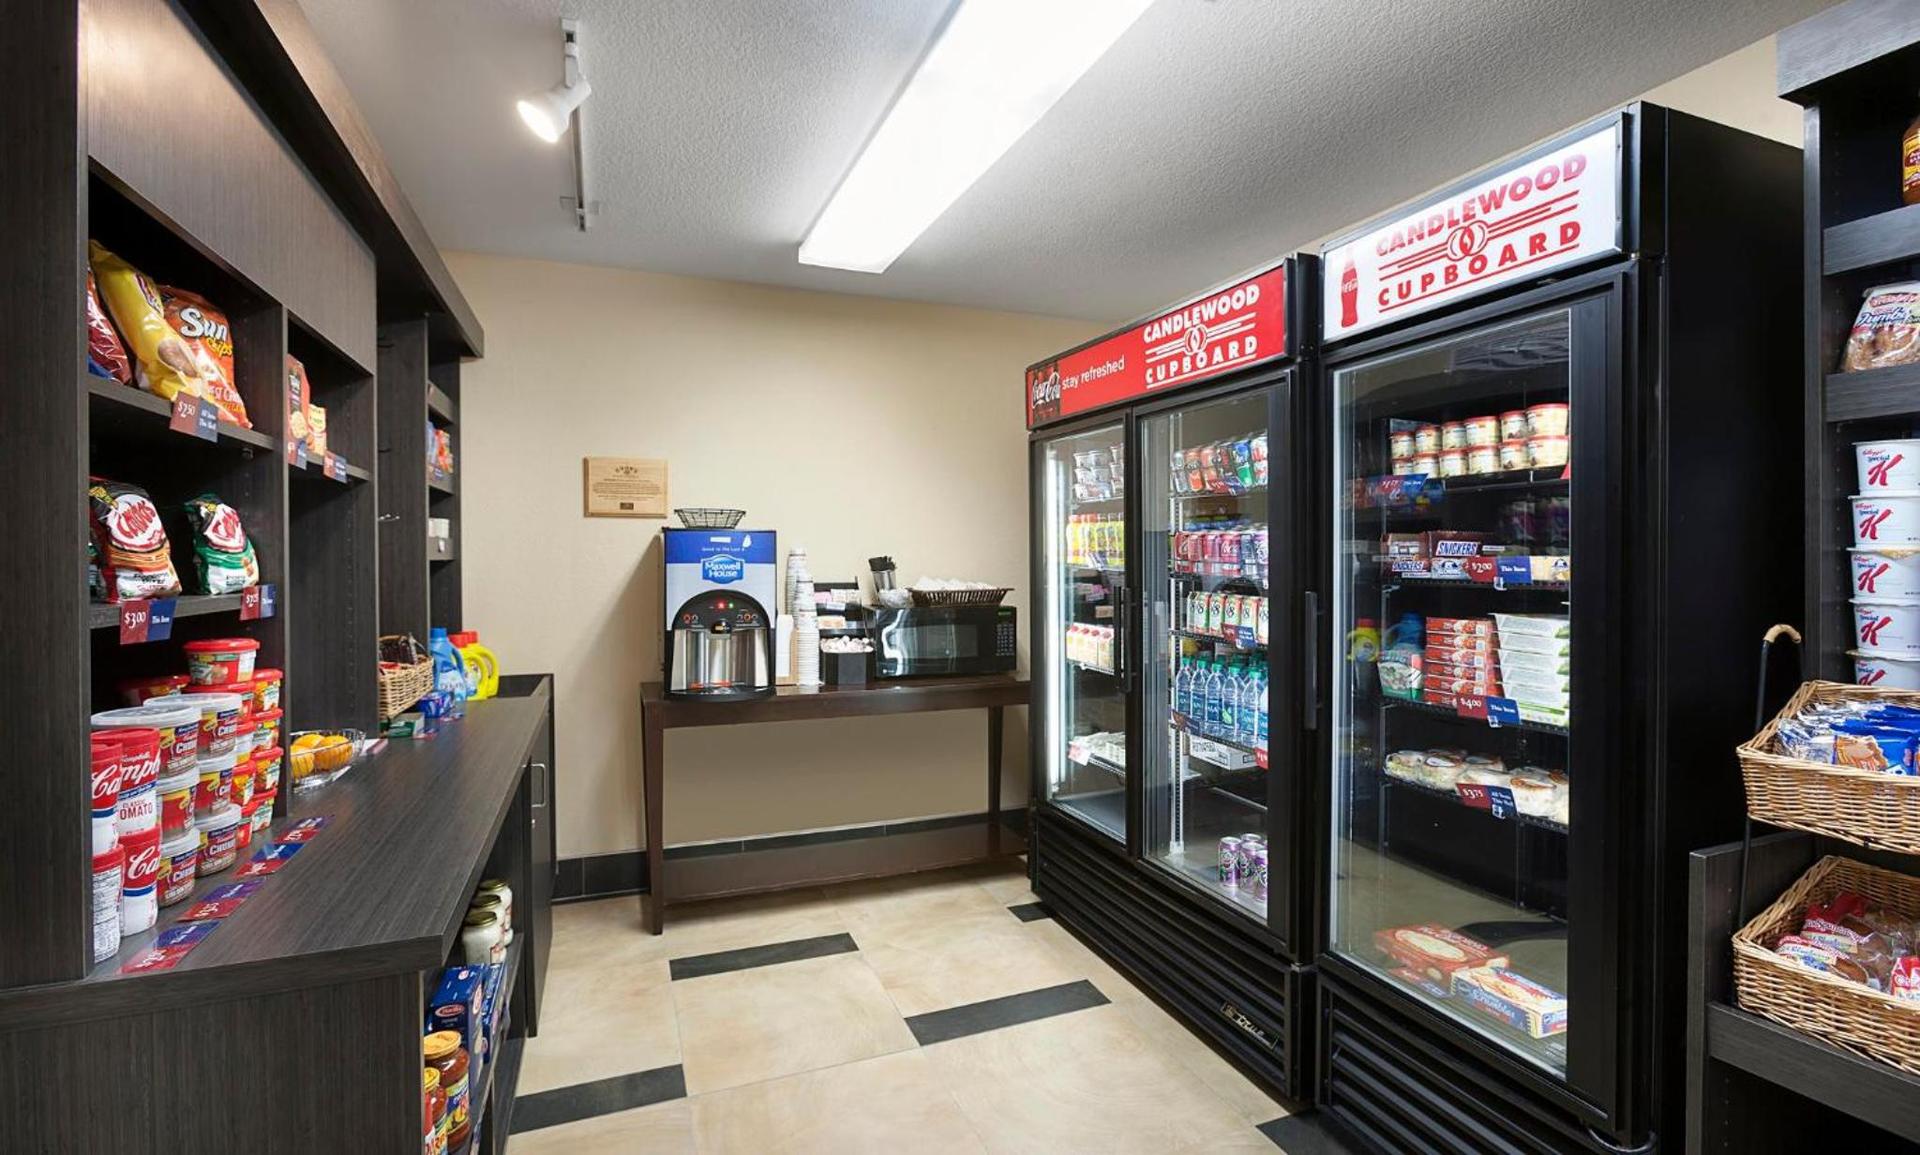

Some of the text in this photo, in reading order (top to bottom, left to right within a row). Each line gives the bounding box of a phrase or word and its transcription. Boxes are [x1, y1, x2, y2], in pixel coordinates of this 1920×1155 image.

[1376, 153, 1587, 257] CANDLEWOOD
[1379, 221, 1581, 306] CUPBOARD
[180, 307, 228, 341] Sun
[1143, 284, 1260, 344] CANDLEWOOD
[1062, 355, 1125, 390] stay refreshed
[1145, 336, 1258, 383] CUPBOARD
[1868, 453, 1905, 486] K
[1859, 508, 1894, 540] K
[1439, 541, 1478, 556] SNICKERS
[704, 560, 741, 571] Maxwell
[708, 569, 738, 578] House
[1857, 562, 1892, 594] K
[1860, 616, 1893, 646] K
[120, 803, 153, 820] OMATO
